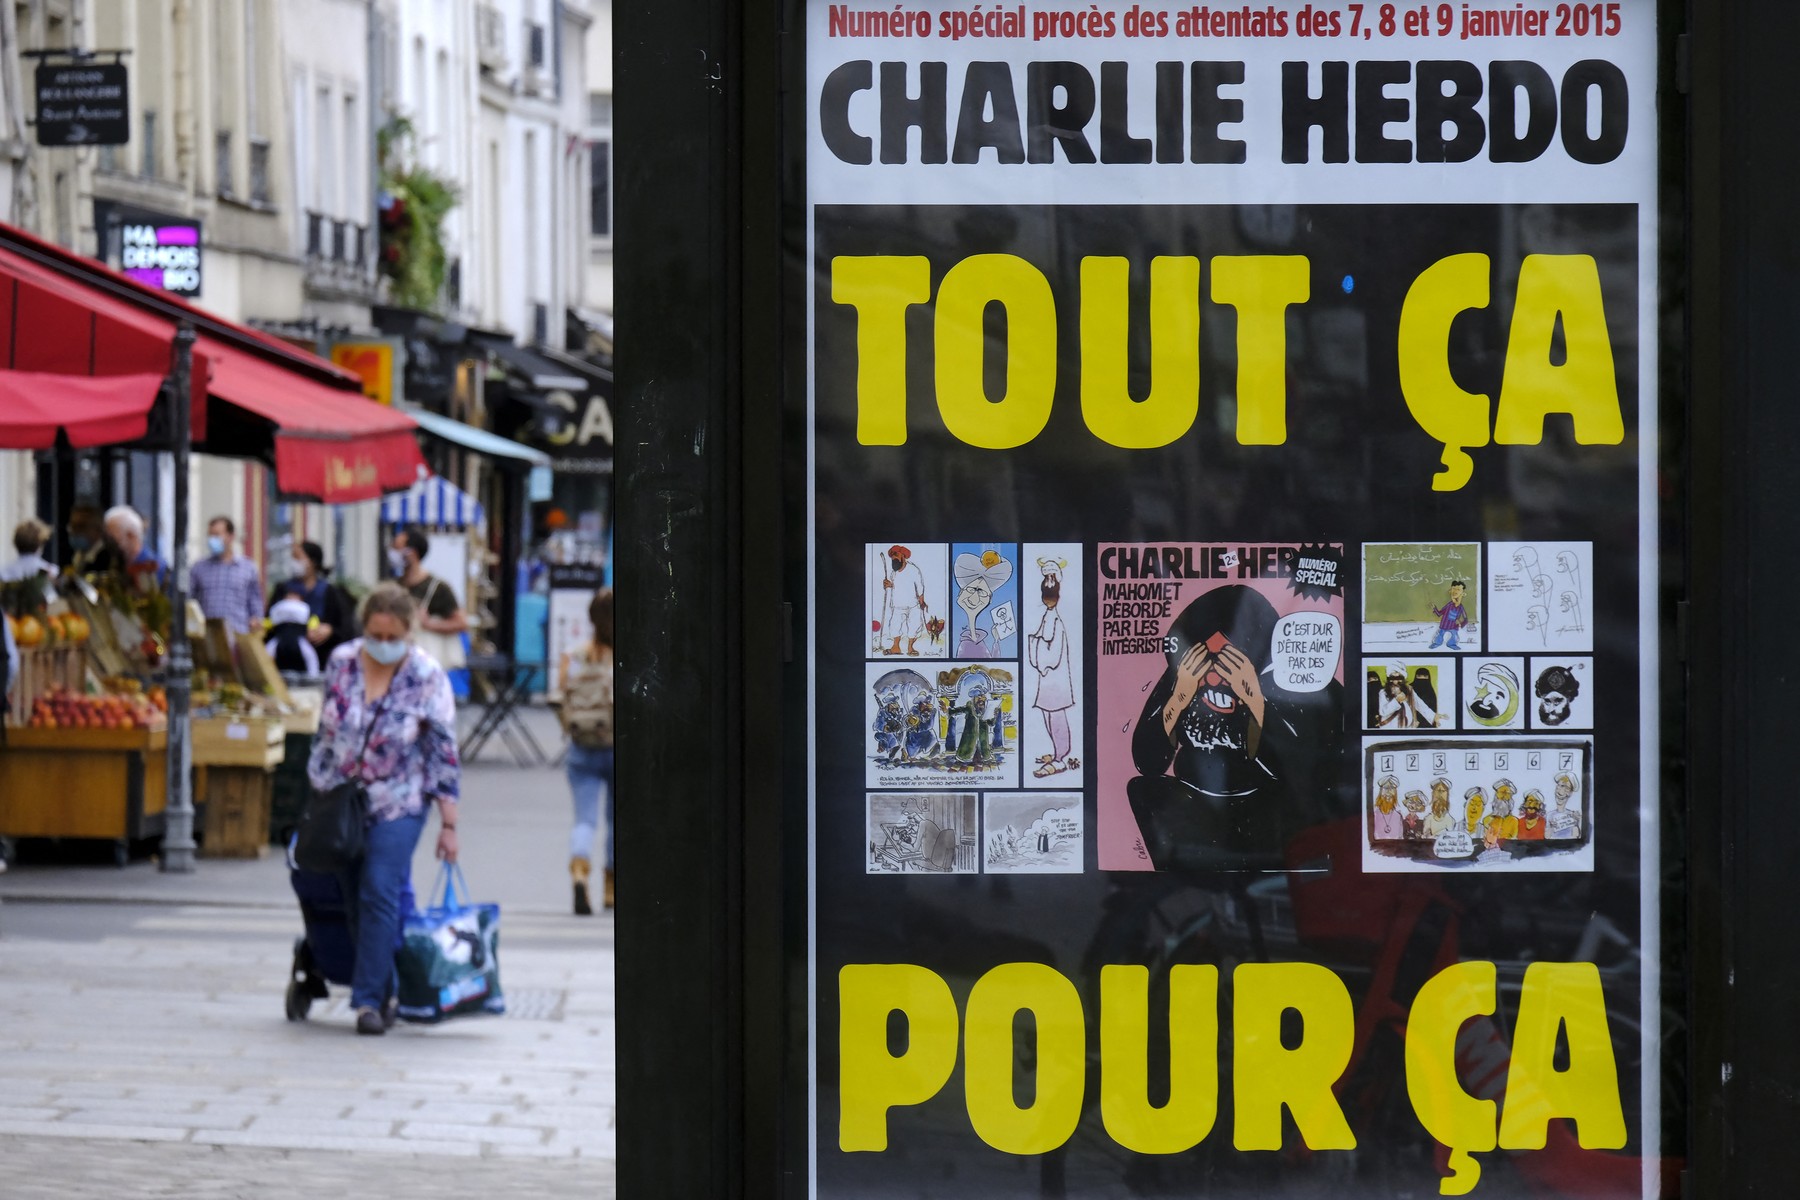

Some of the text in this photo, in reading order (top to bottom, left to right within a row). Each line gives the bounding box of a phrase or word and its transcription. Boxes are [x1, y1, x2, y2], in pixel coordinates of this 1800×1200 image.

[829, 3, 1622, 42] Numéro spécial procès des attentats des 7, 8 et 9 janvier 2015
[820, 59, 1630, 165] CHARLIE HEBDO
[123, 224, 157, 247] MA
[123, 245, 199, 269] DEMOIS
[163, 268, 200, 291] BIO
[831, 252, 1625, 492] TOUT ÇA
[1100, 547, 1294, 579] CHARLIE HEB
[1224, 554, 1238, 566] 2€
[1298, 557, 1338, 573] NUMÉRO
[1102, 582, 1183, 601] MAHOMET
[1102, 601, 1171, 619] DÉBORDÉ
[1102, 619, 1159, 637] PAR LES
[1283, 621, 1334, 637] C'EST DUR
[1288, 656, 1325, 670] PAR DES
[838, 960, 1628, 1196] POUR ÇA
